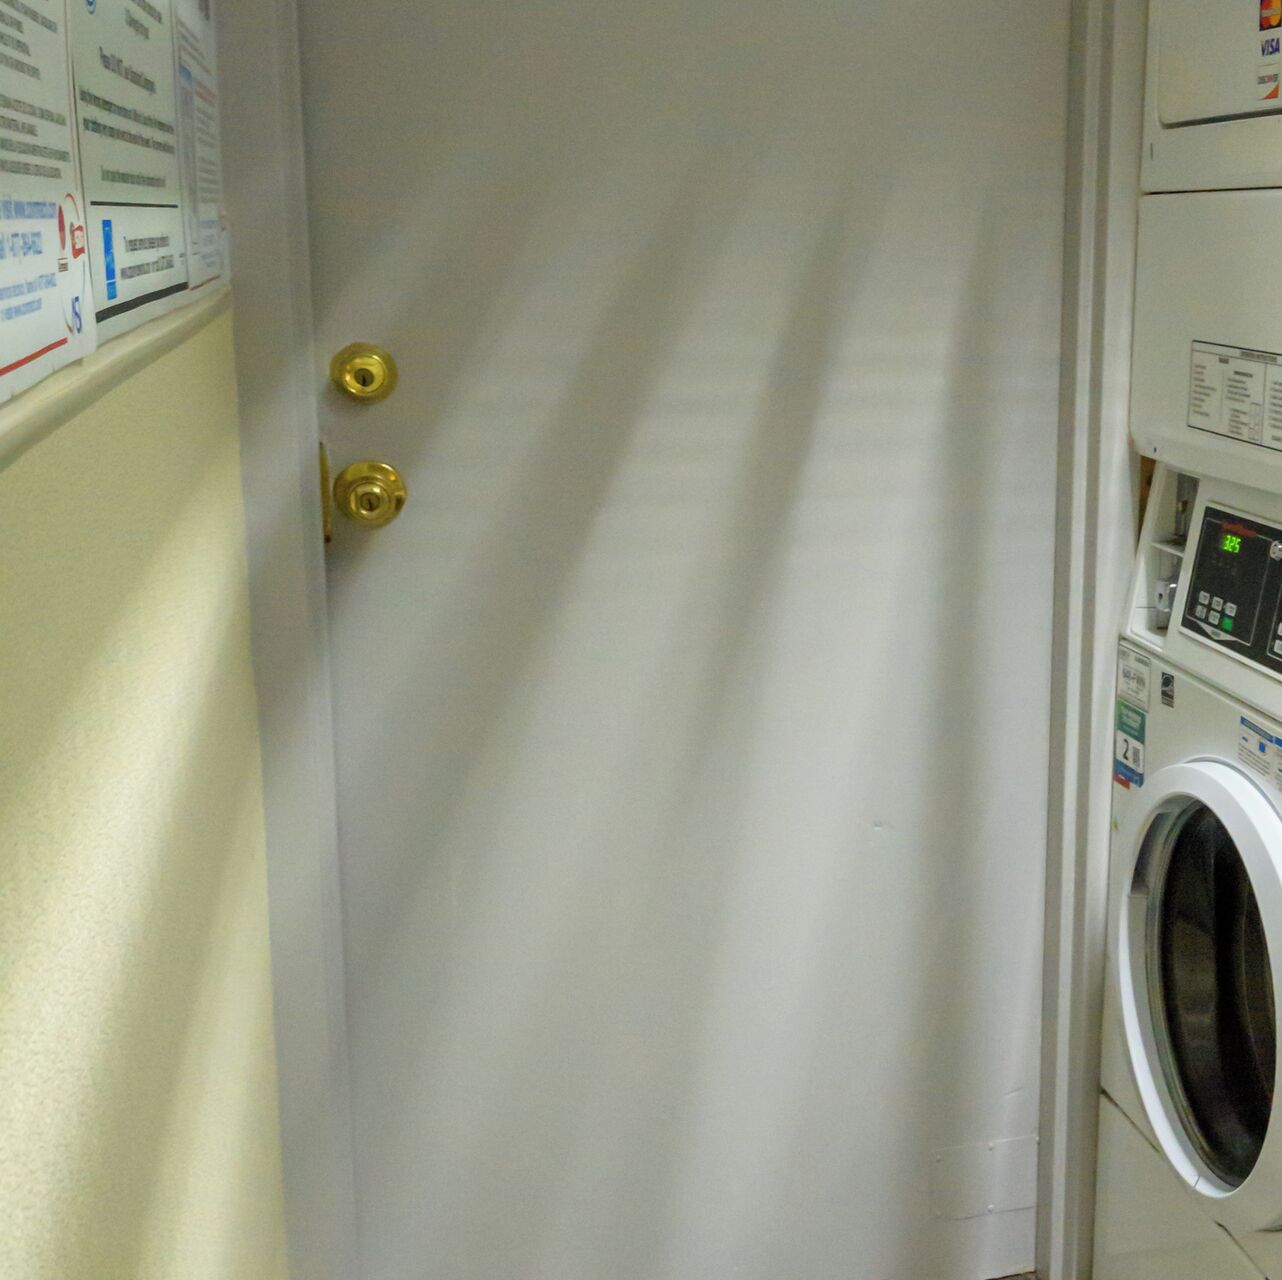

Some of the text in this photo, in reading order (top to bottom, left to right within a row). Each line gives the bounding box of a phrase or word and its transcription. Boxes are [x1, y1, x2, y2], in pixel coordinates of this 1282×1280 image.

[1261, 37, 1280, 57] VISA
[1223, 535, 1242, 553] 325
[1123, 738, 1129, 761] 2
